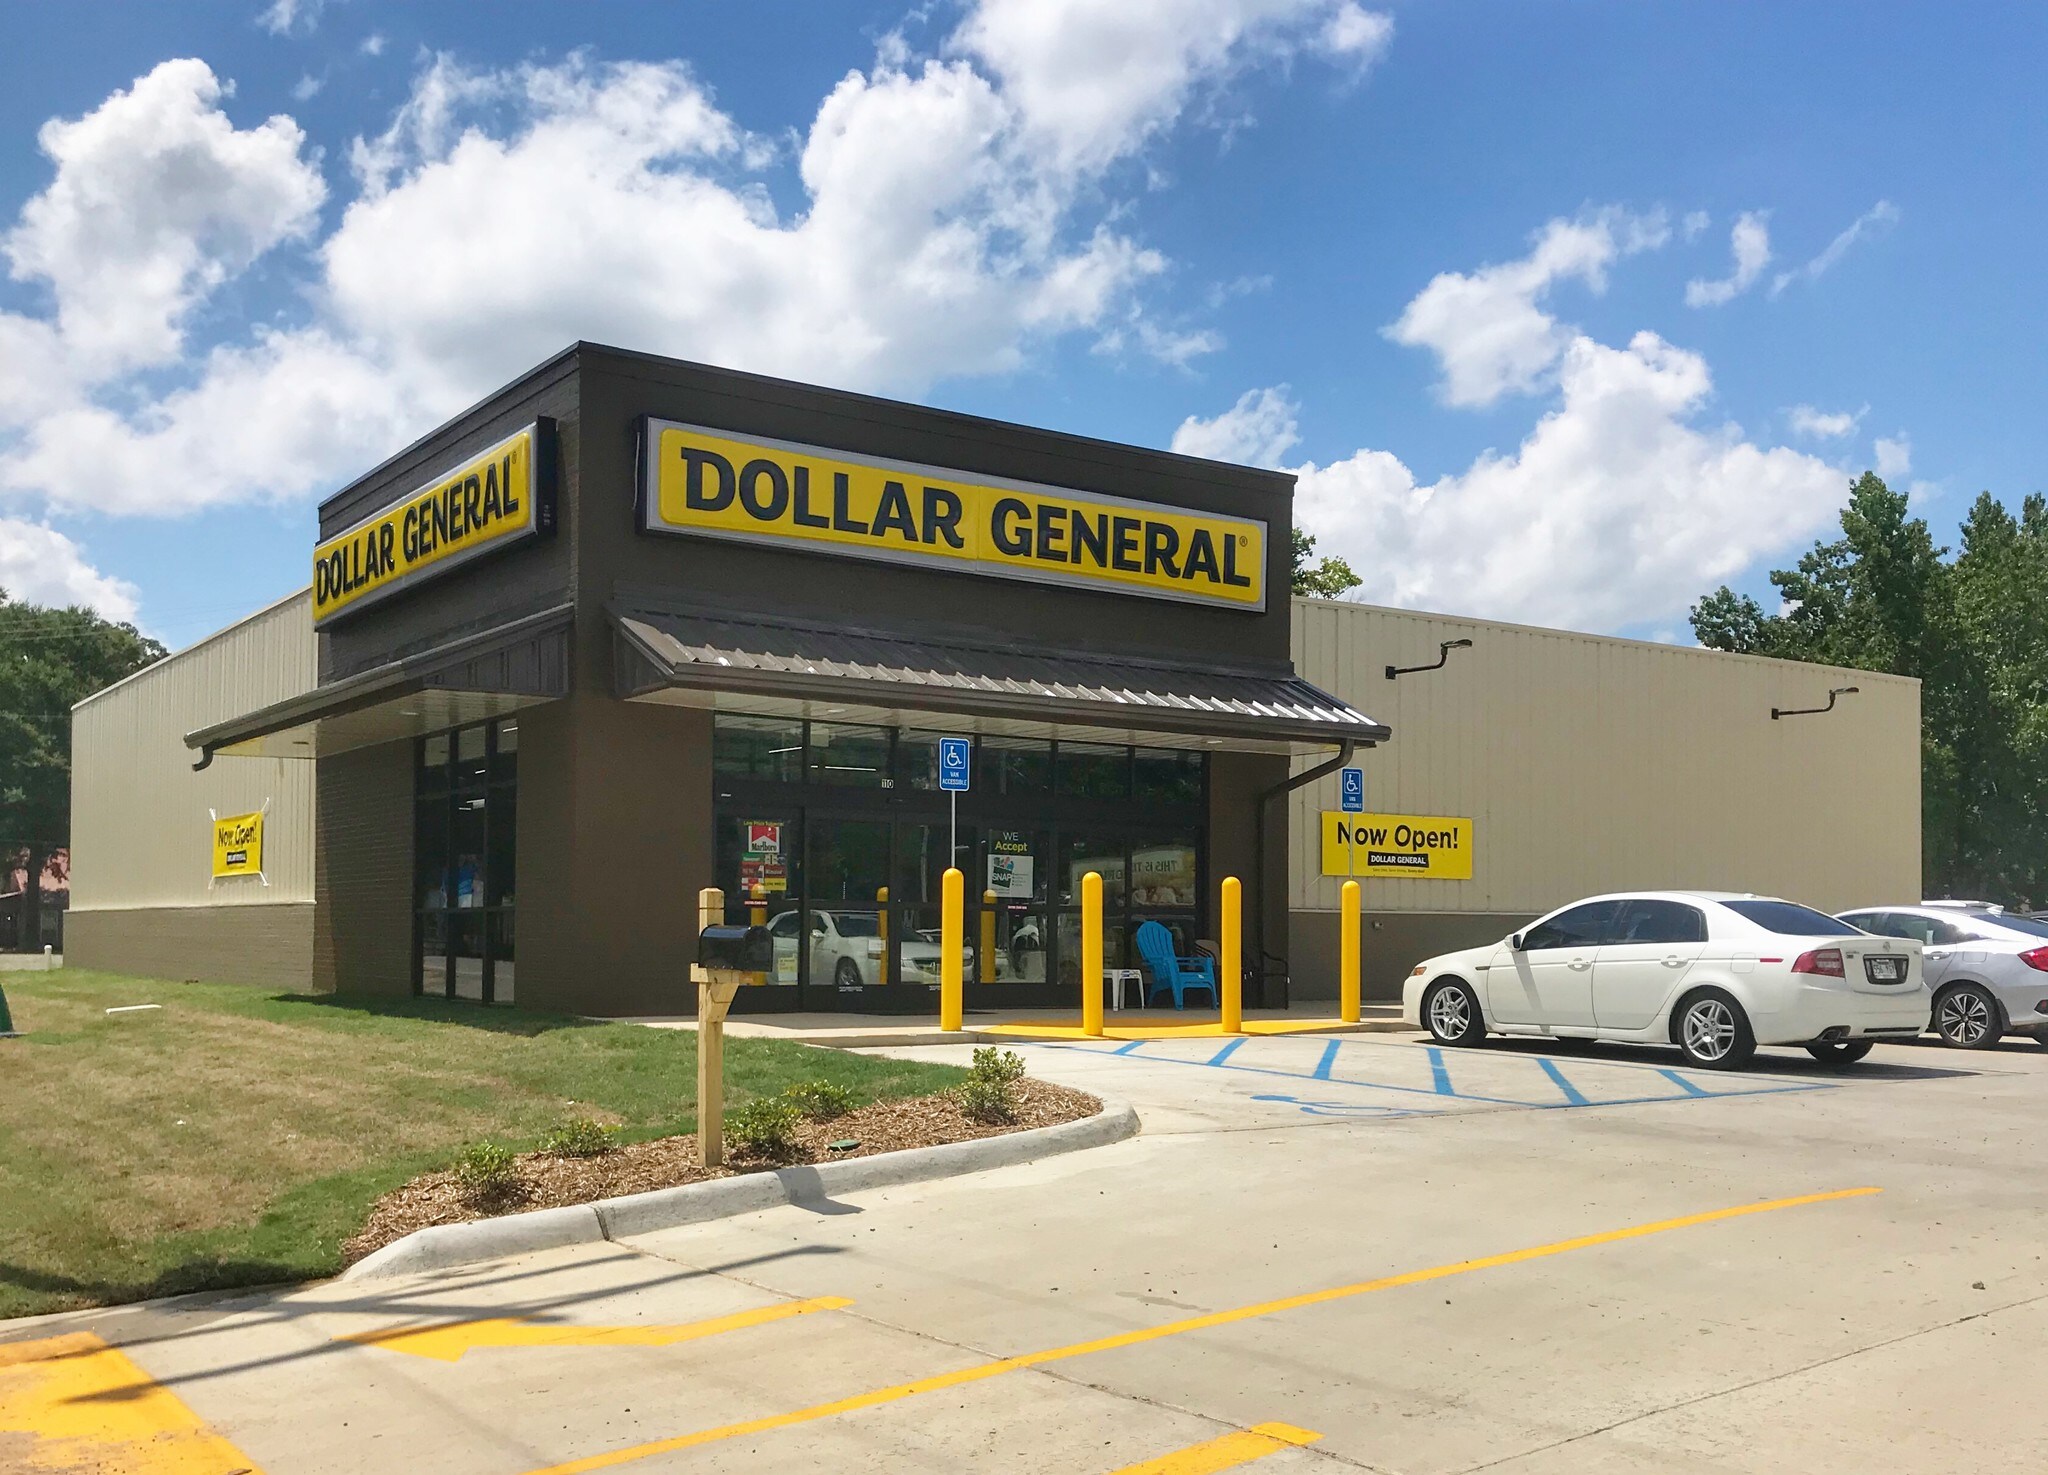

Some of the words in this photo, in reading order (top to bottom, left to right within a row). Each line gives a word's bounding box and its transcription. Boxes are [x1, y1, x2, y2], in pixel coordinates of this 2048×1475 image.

[680, 446, 965, 549] DOLLAR
[316, 521, 395, 607] DOLLAR
[403, 455, 519, 563] GENERAL
[881, 779, 894, 789] 110
[942, 778, 967, 786] ACCESSIBLE
[218, 828, 234, 847] Now
[235, 821, 257, 848] Open!
[1003, 832, 1019, 841] WE
[1337, 821, 1388, 846] Now
[1394, 824, 1459, 852] Open!
[751, 841, 777, 852] Marlboro
[995, 841, 1028, 853] Accept
[1370, 855, 1396, 864] DOLLAR
[1397, 856, 1427, 865] GENERAL
[992, 872, 1012, 881] SNAP
